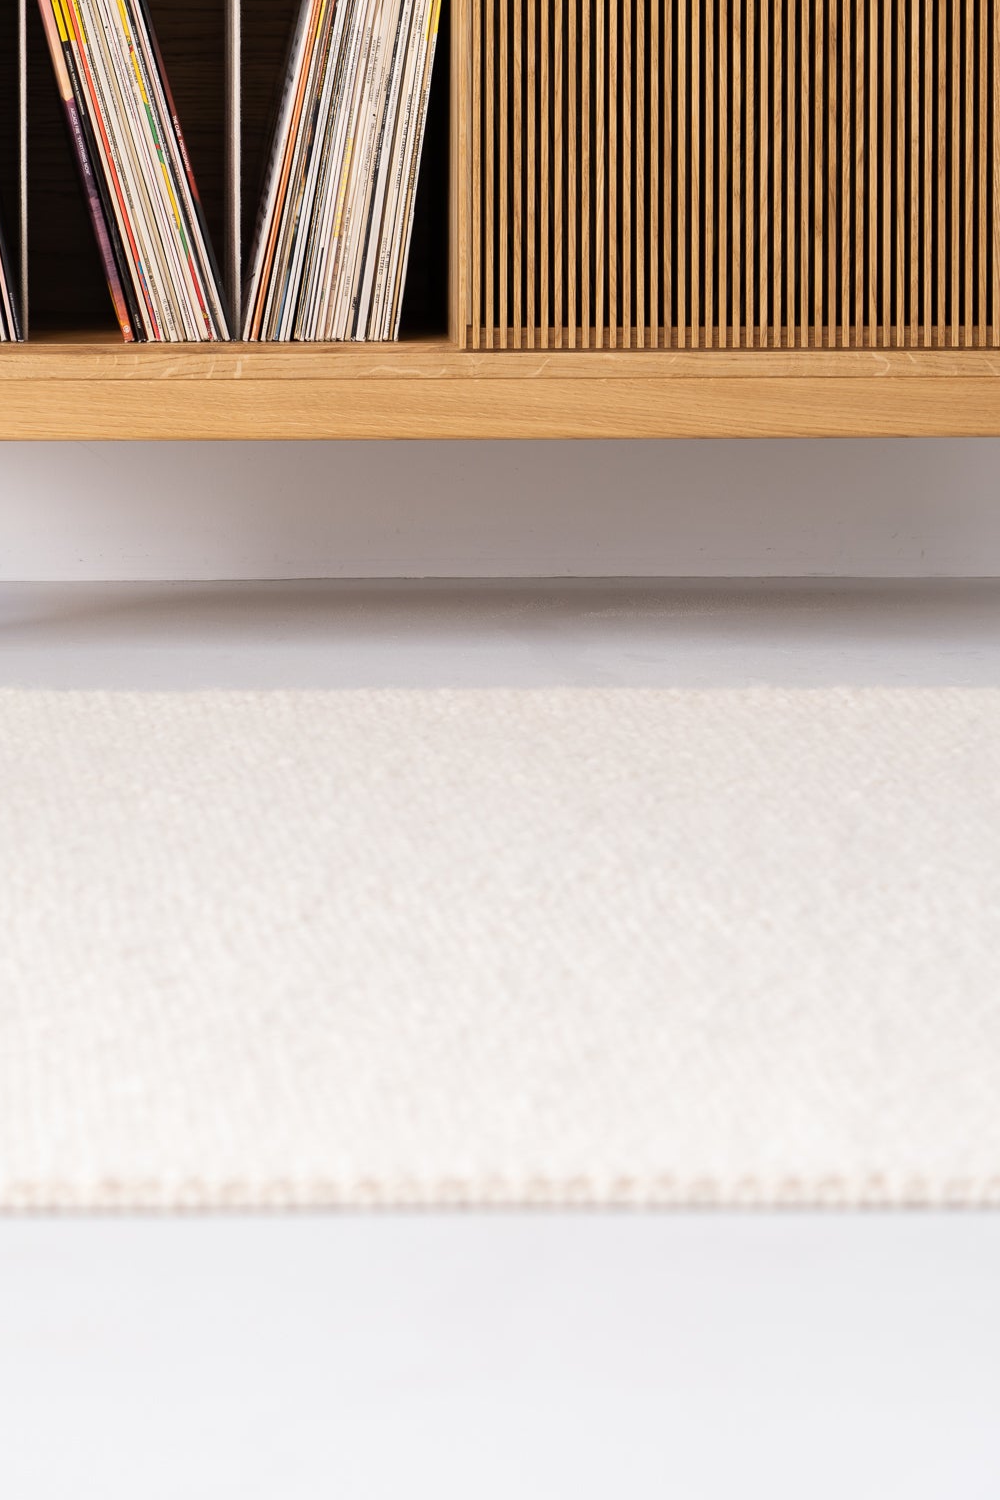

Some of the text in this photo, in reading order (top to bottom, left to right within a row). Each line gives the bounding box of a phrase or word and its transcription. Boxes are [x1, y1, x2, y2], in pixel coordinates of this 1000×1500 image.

[69, 106, 79, 126] ARCADE
[76, 134, 88, 163] "EVERYTHING
[83, 162, 91, 177] NOW"
[174, 123, 182, 137] CURE
[178, 138, 191, 172] PORNOGRAPHY
